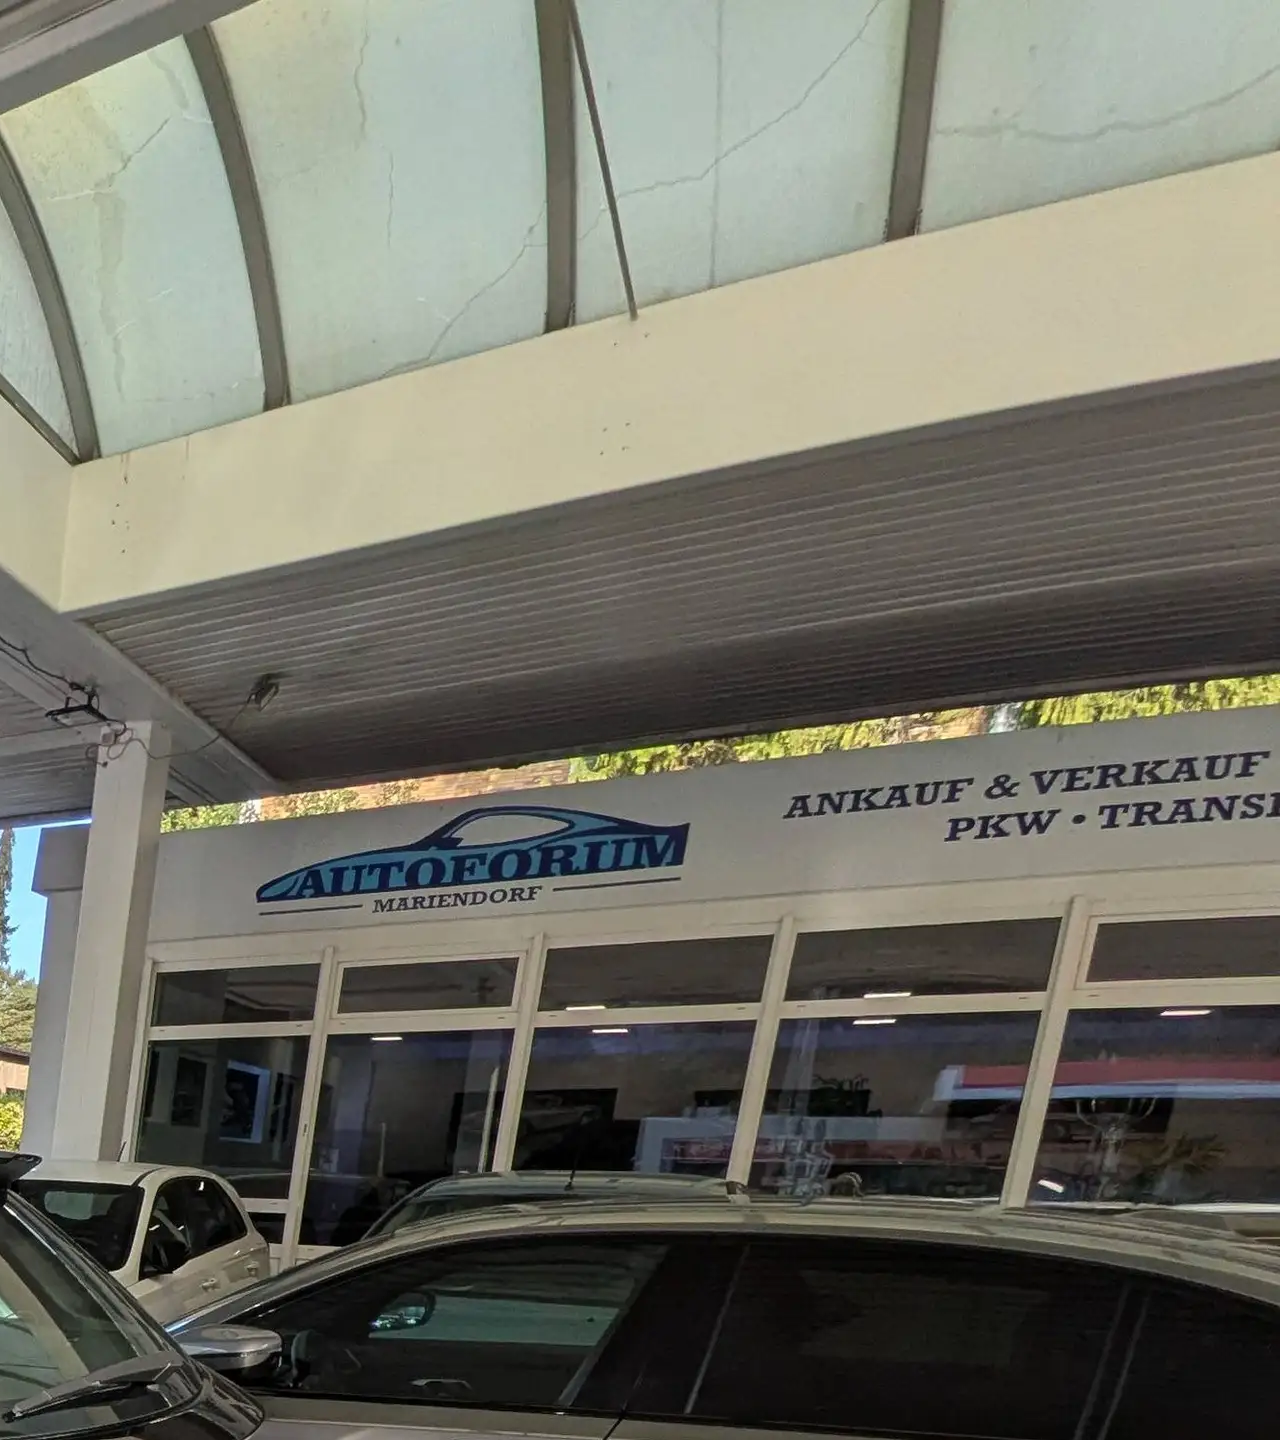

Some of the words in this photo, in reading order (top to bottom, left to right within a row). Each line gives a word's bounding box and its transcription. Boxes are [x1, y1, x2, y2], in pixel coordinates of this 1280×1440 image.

[783, 778, 974, 818] ANKAUF
[983, 774, 1020, 799] &
[1030, 751, 1271, 794] VERKAUF
[944, 809, 1061, 842] PKW
[295, 826, 690, 899] AUTOFORUM
[372, 886, 543, 914] MARIENDORF
